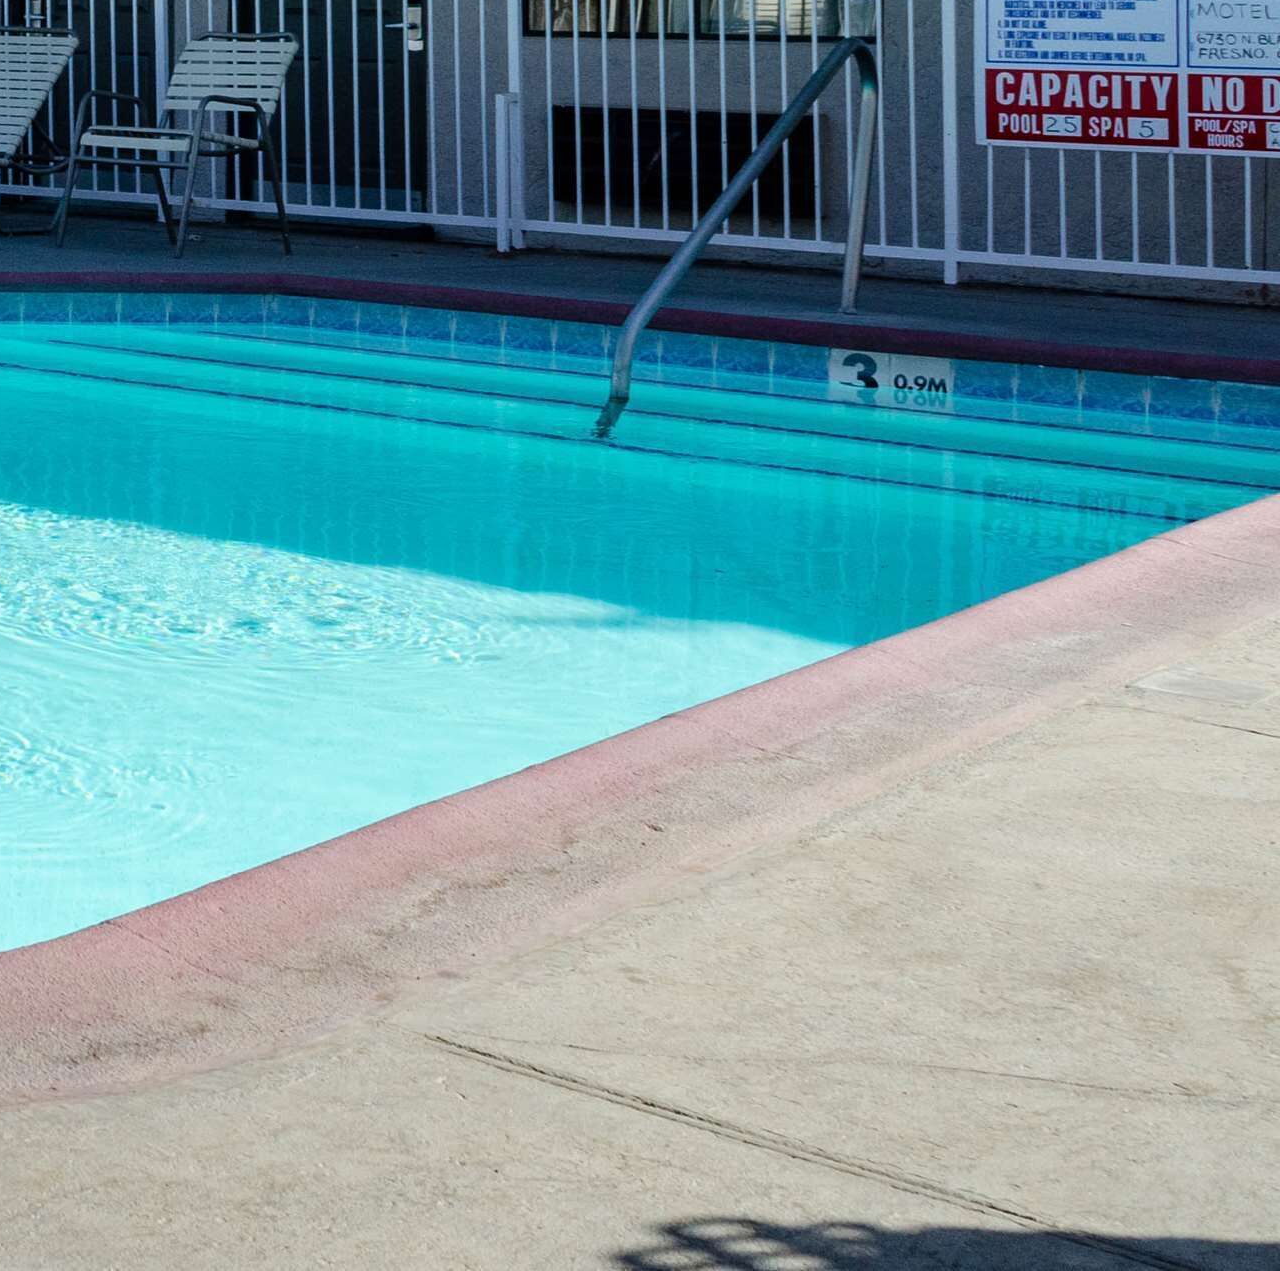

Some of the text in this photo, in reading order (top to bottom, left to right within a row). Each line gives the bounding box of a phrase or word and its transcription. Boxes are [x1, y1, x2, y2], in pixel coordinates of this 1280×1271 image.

[1197, 2, 1280, 19] MOTEL
[995, 73, 1173, 111] CAPACITY
[1202, 77, 1245, 113] NO
[998, 113, 1155, 138] POOL 25 SPA 5
[1194, 119, 1257, 134] POOL/SPA
[1207, 133, 1244, 148] HOURS
[840, 352, 948, 393] 3 0.9M
